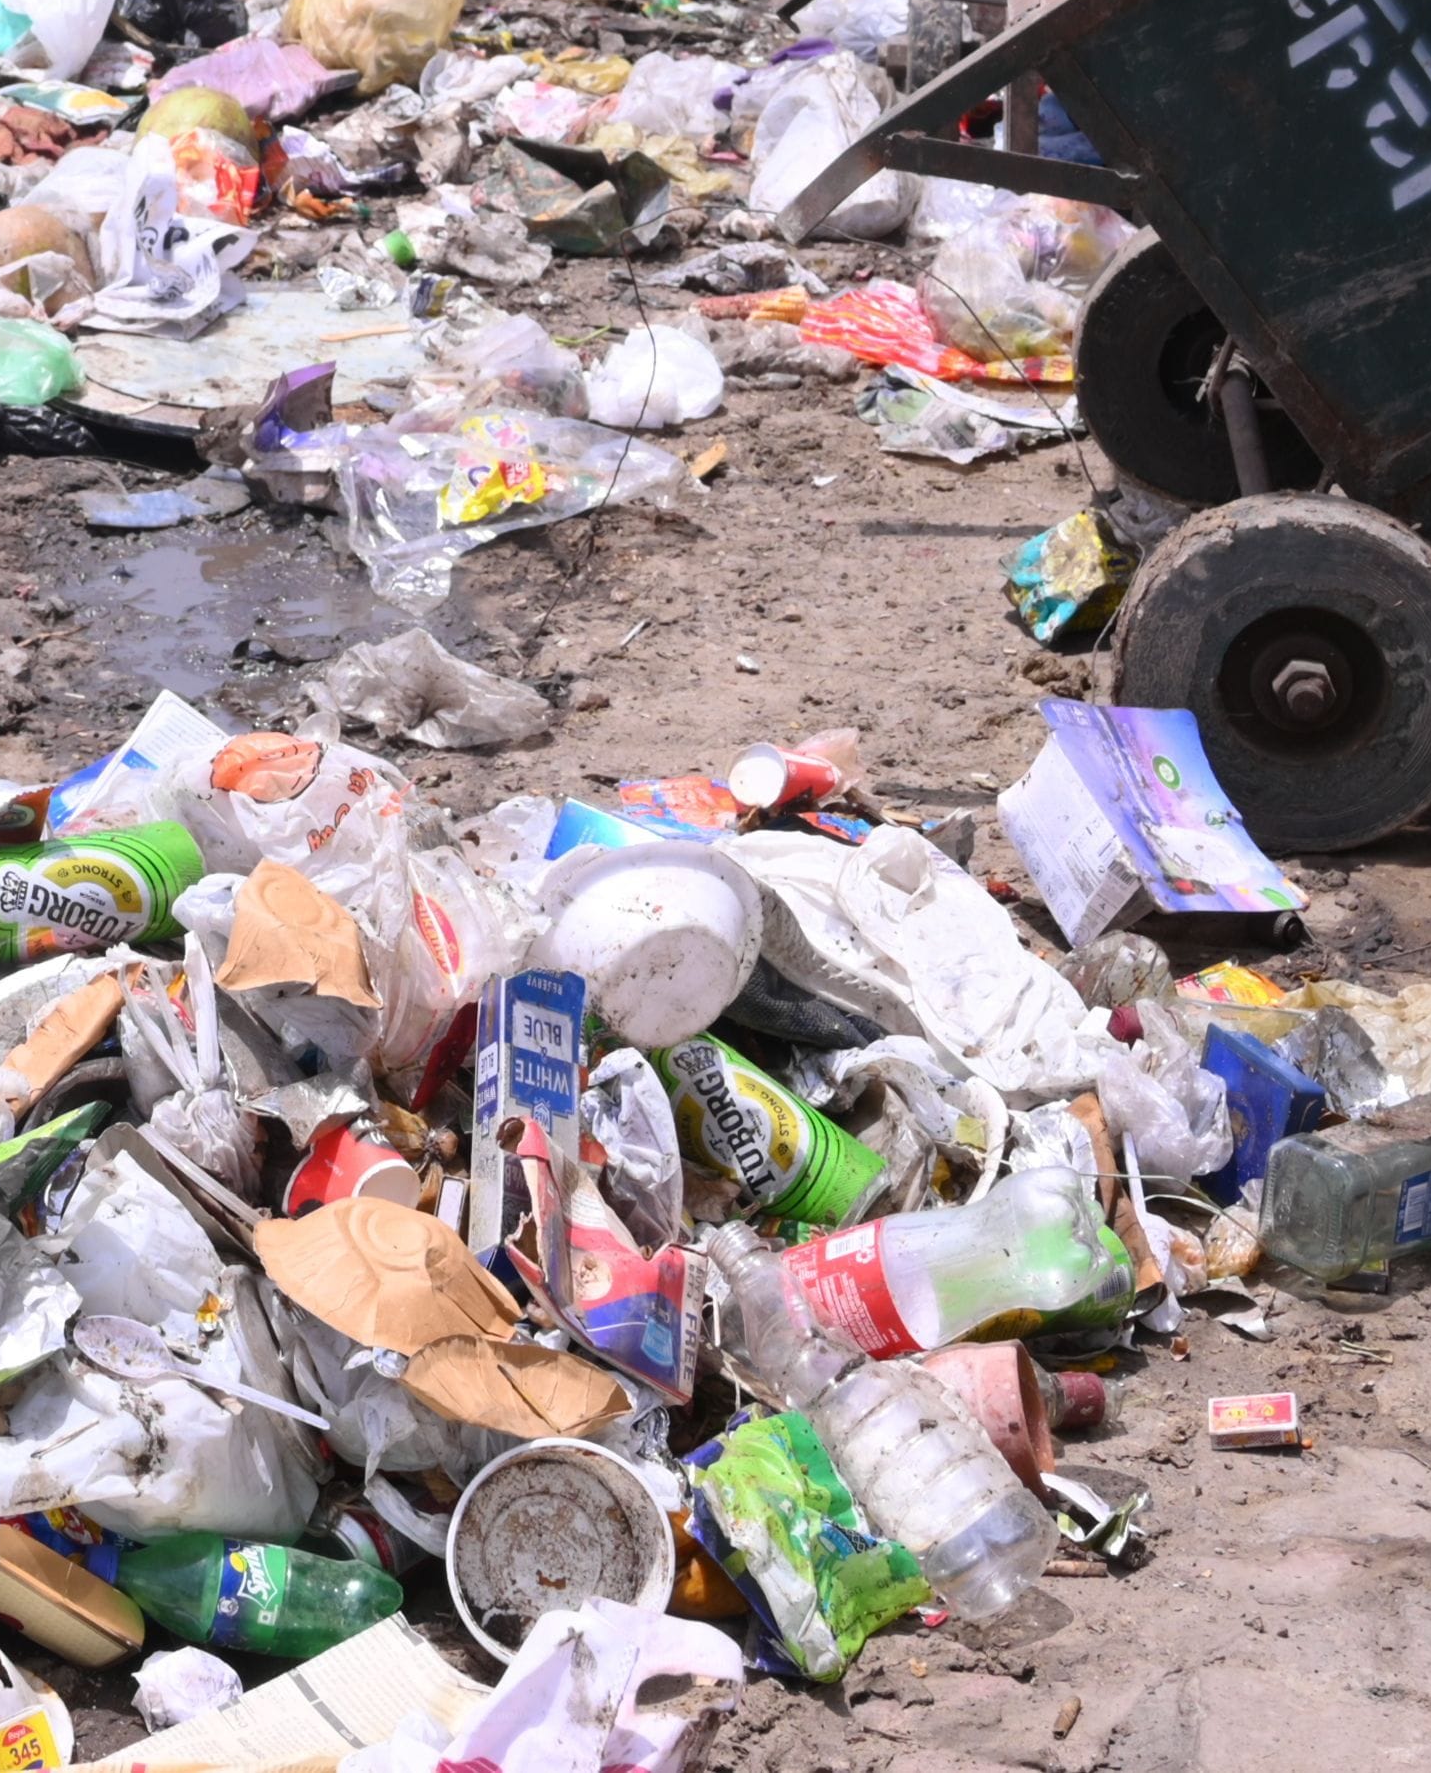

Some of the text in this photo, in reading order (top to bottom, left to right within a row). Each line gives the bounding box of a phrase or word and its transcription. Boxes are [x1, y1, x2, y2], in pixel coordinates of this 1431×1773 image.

[69, 863, 126, 889] STRONG
[26, 884, 144, 947] TUBORG
[526, 974, 562, 996] RESERVE
[524, 1015, 562, 1046] BLUE
[480, 1052, 494, 1074] BLUE
[758, 1088, 794, 1144] STRONG
[693, 1070, 778, 1199] TUBORG
[684, 1312, 697, 1379] FREE
[8, 1735, 43, 1770] 345
